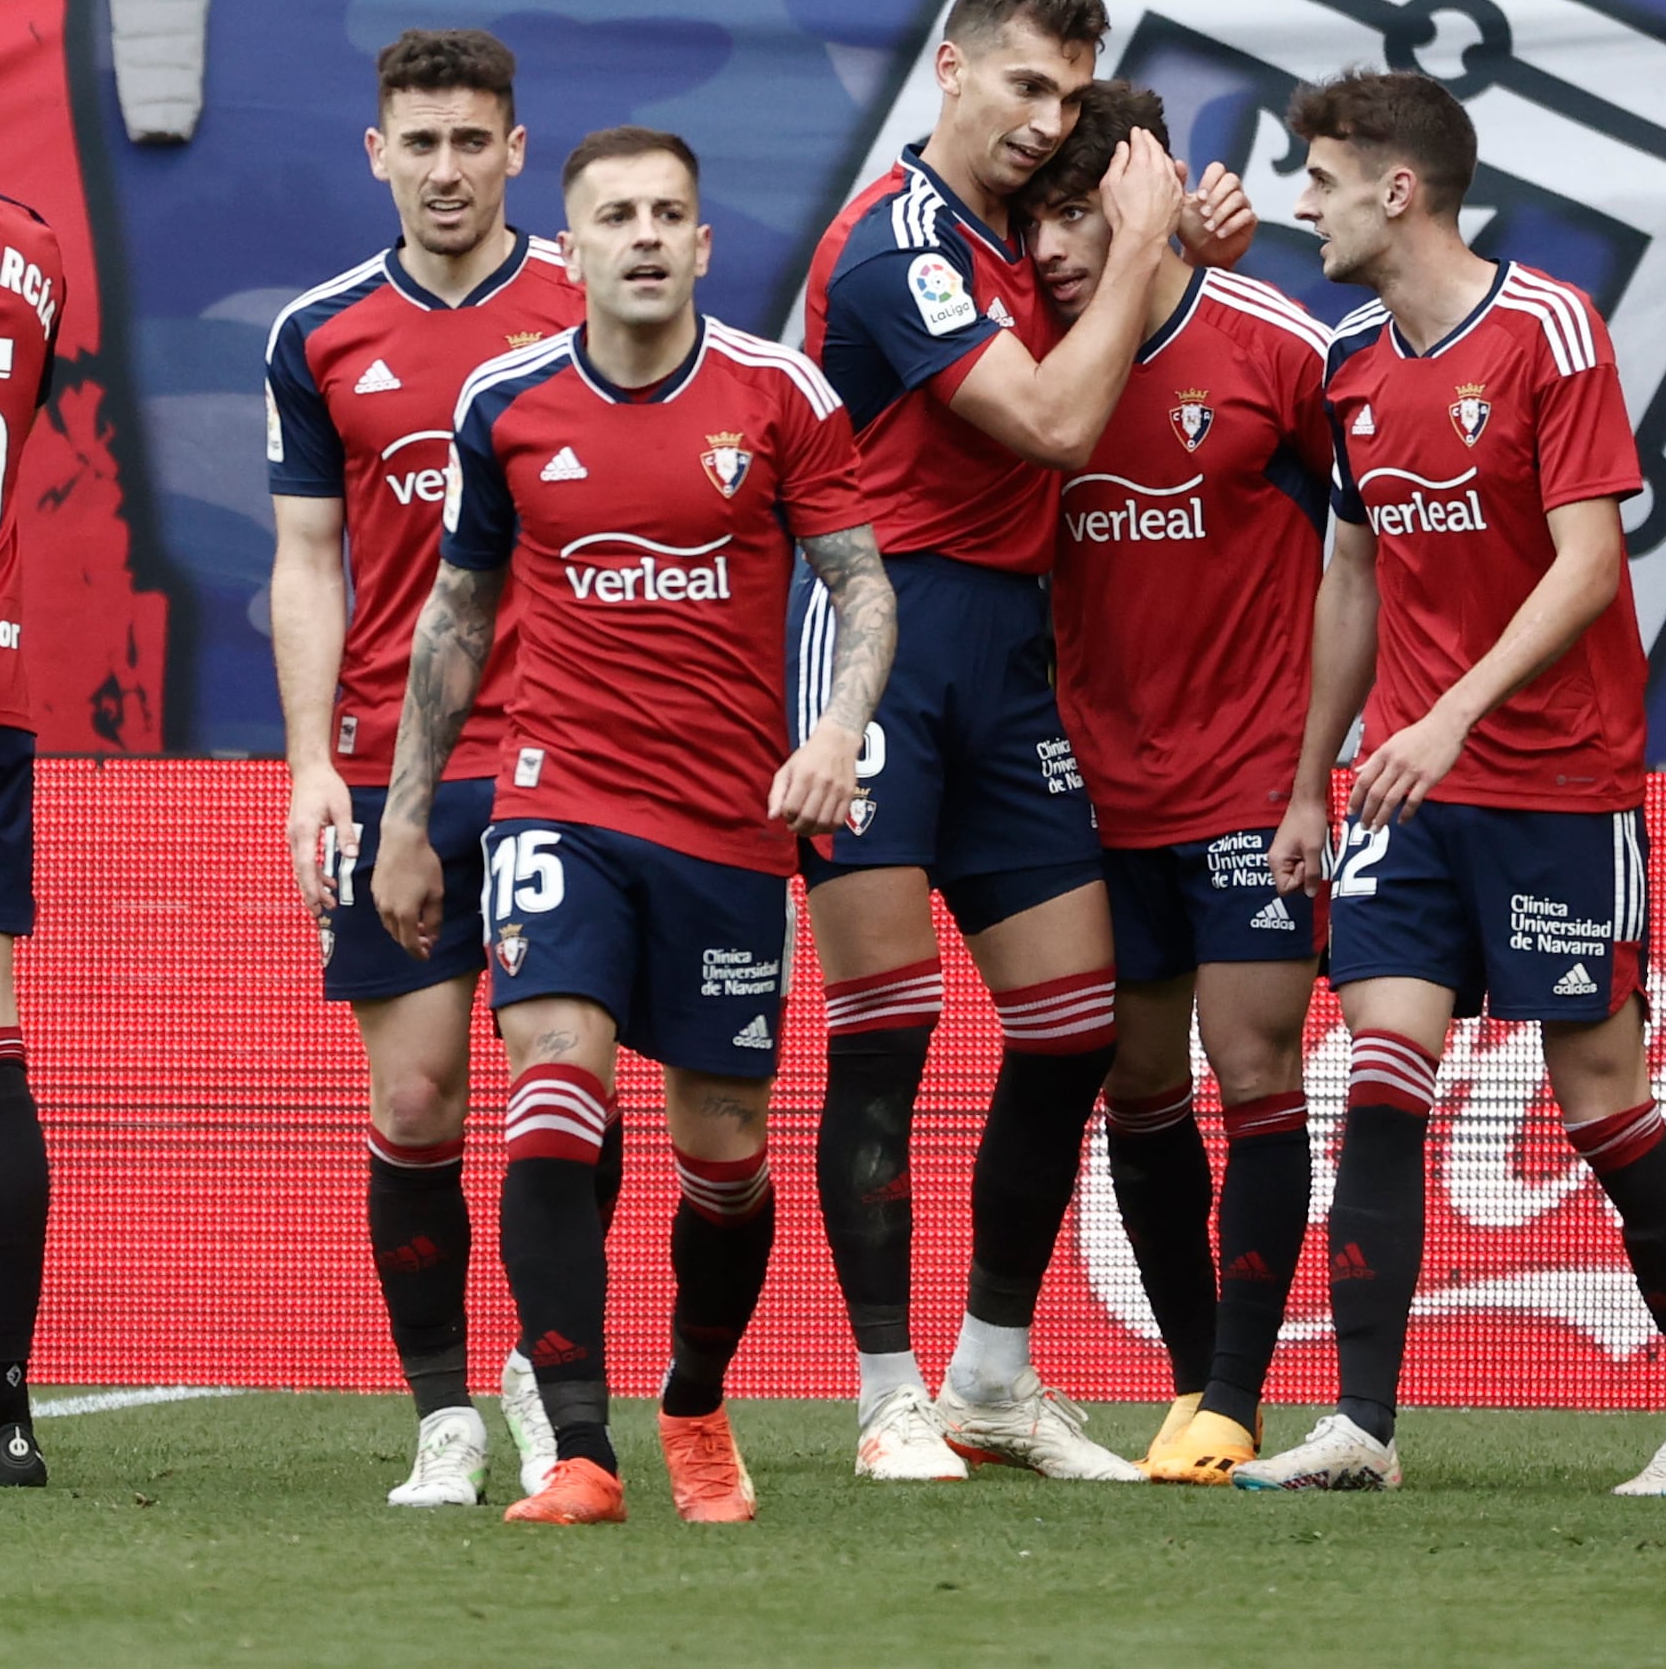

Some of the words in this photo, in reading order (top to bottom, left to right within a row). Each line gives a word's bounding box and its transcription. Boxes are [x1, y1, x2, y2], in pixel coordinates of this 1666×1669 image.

[929, 300, 971, 325] LaLiga
[1064, 497, 1206, 543] verleal
[1365, 490, 1488, 537] verleal
[564, 556, 732, 603] verleal
[491, 828, 566, 921] 15
[1206, 851, 1270, 873] Univers
[1210, 871, 1230, 889] de
[1233, 869, 1276, 888] Nava
[1510, 893, 1569, 918] Clínica
[1250, 916, 1297, 931] adidas
[1510, 913, 1613, 939] Universidad
[703, 947, 753, 965] Clínica
[1509, 931, 1533, 952] de
[1537, 933, 1606, 958] Navarra
[703, 959, 780, 981] Universidad
[701, 980, 722, 997] de
[724, 977, 775, 996] Navarra
[1552, 980, 1599, 996] adidas
